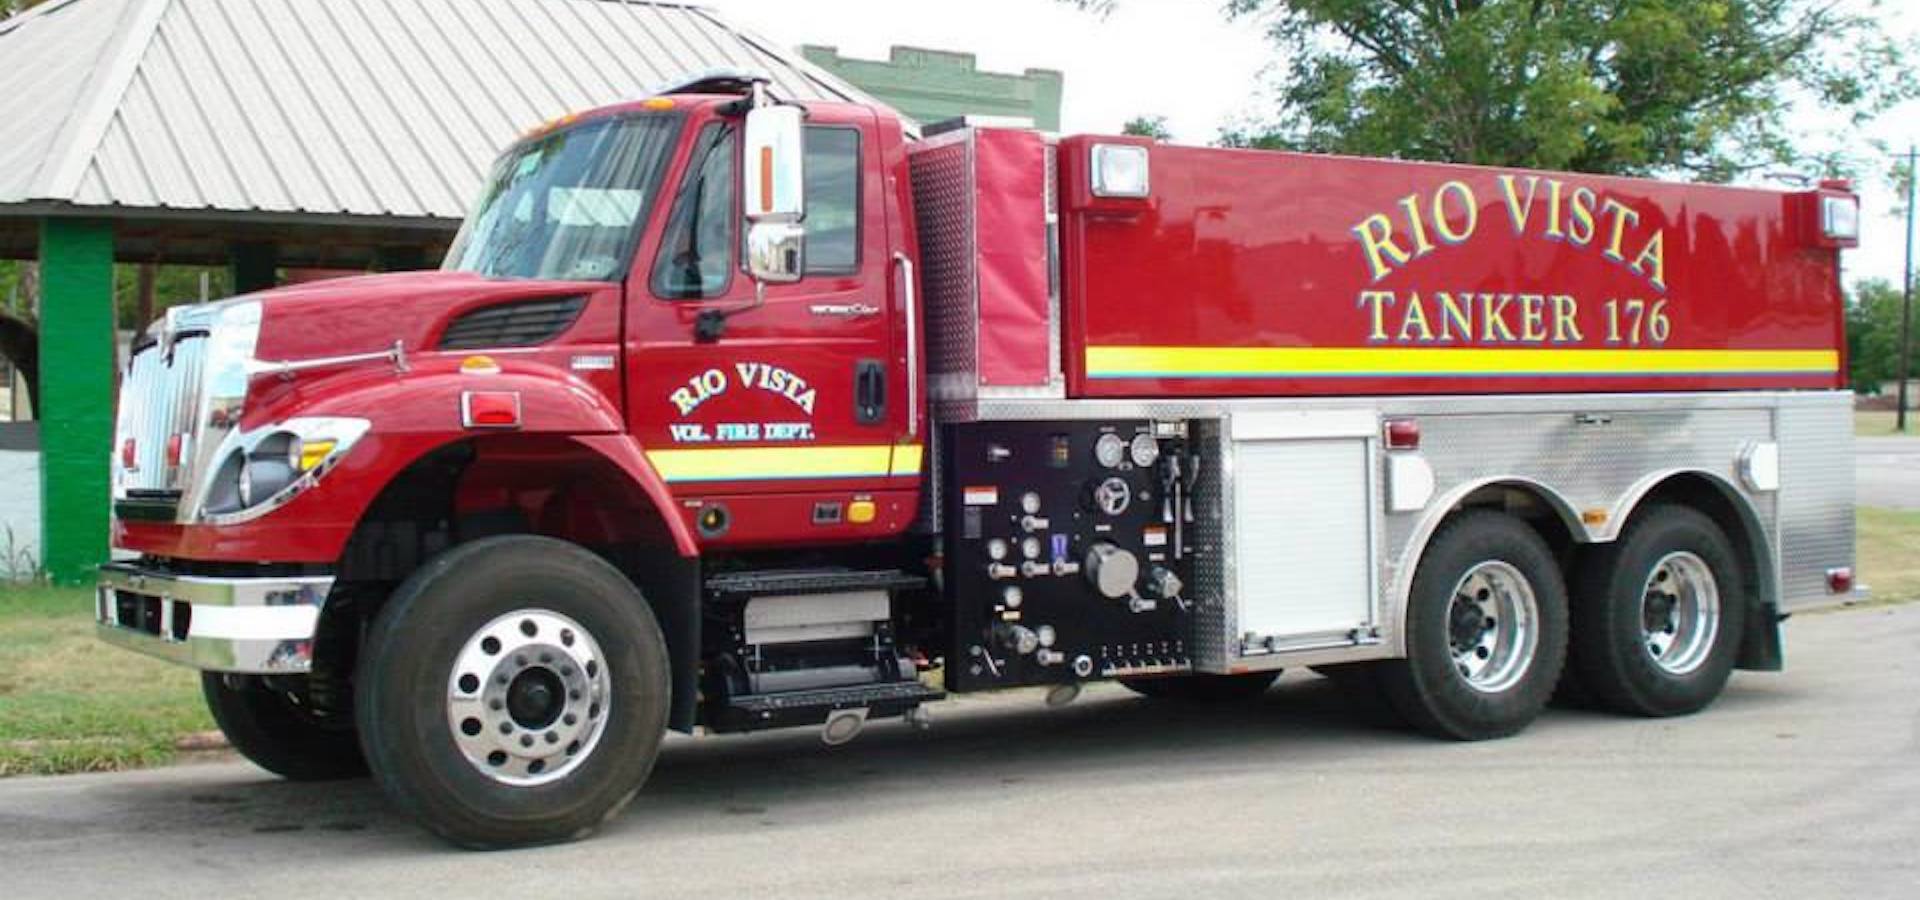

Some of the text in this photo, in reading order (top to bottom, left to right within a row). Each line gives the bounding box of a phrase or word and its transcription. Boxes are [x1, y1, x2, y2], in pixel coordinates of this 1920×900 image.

[1352, 174, 1667, 292] RIO VISTA
[1358, 290, 1671, 344] TANKER 176
[669, 362, 817, 417] RIO VISTA
[669, 422, 816, 442] VOL. FIRE DEPT.
